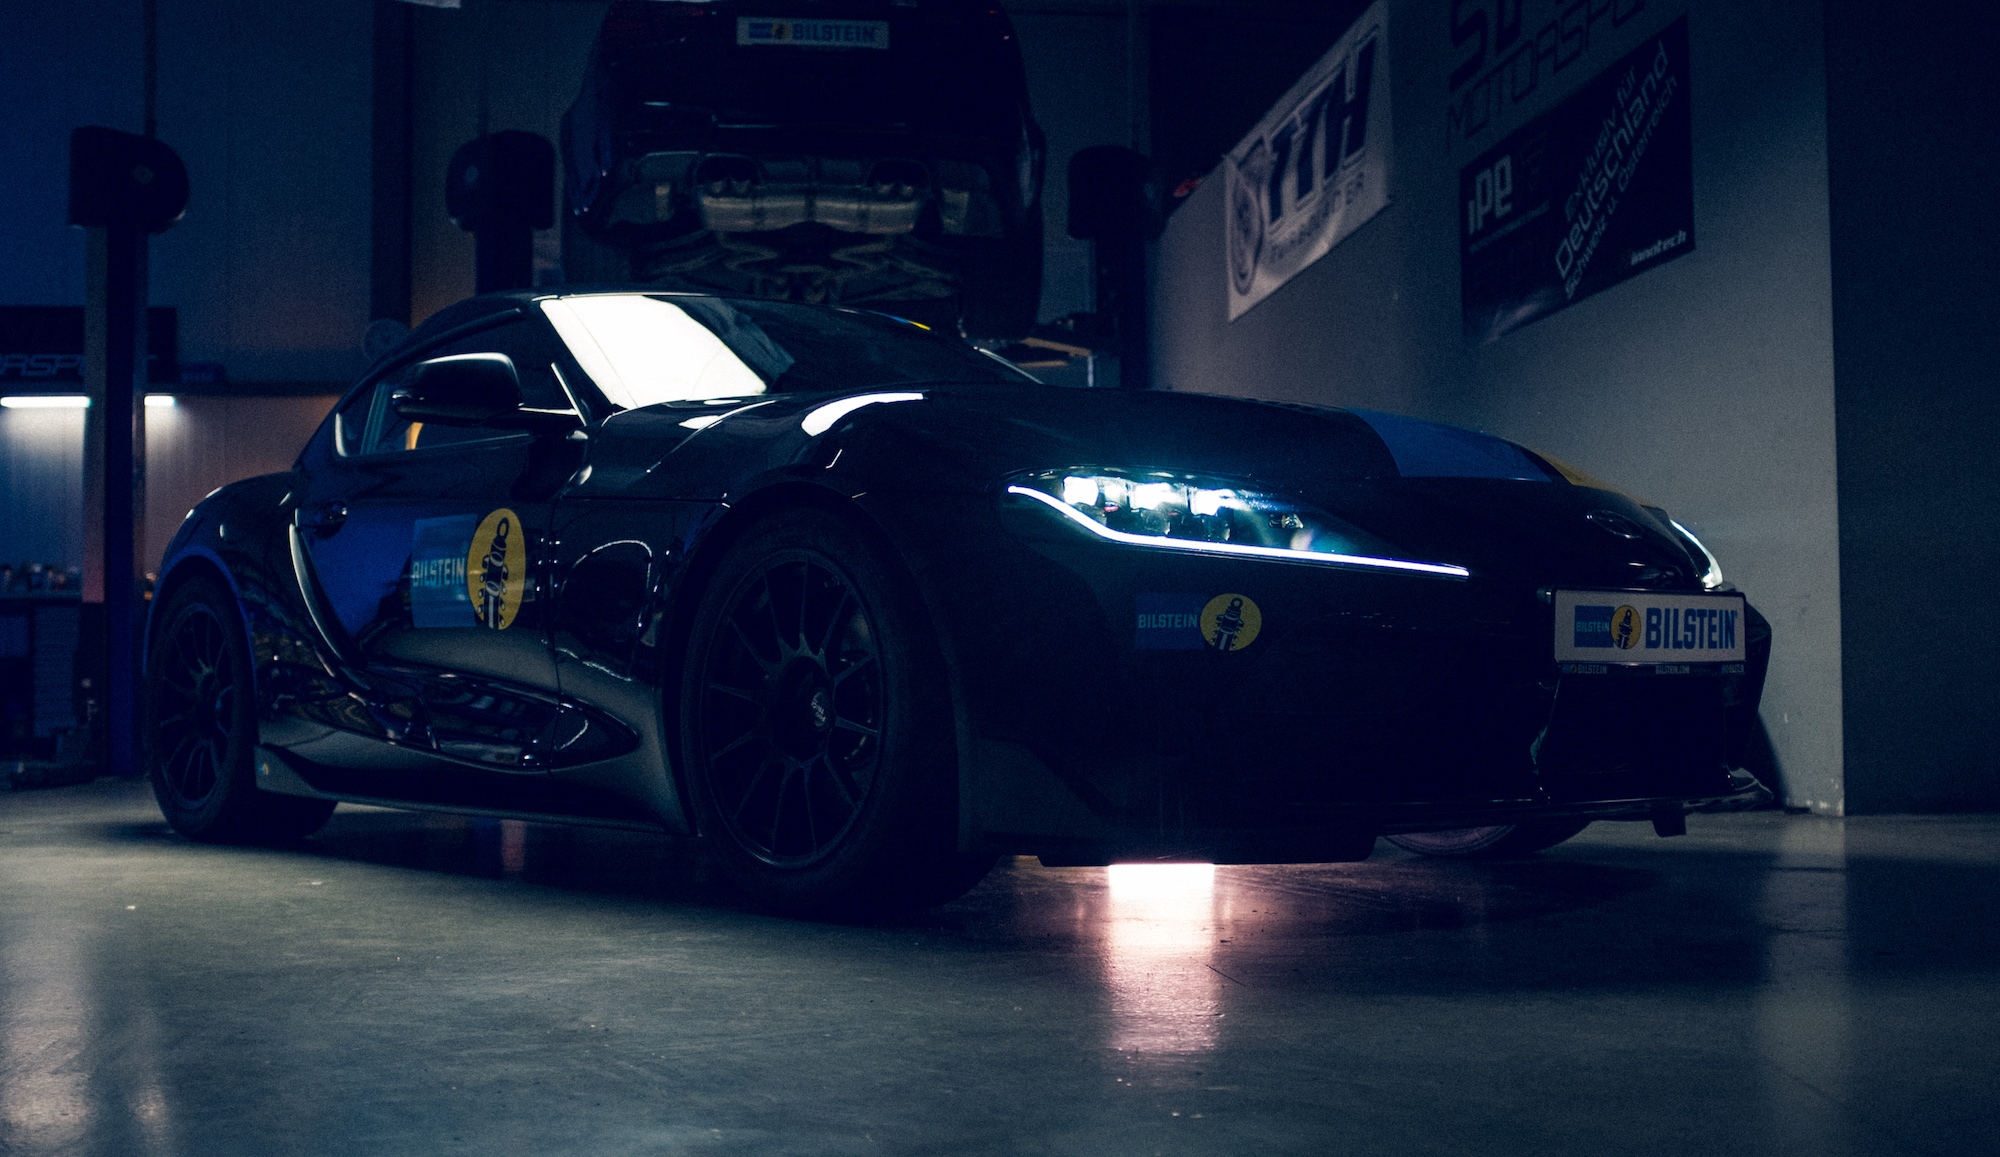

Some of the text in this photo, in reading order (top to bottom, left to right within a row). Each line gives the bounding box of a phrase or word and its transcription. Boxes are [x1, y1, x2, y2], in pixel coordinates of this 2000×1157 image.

[792, 23, 876, 42] BILSTEIN
[1555, 38, 1669, 279] Deutschland
[1565, 213, 1608, 299] Schweiz
[1616, 75, 1678, 193] Österreich
[412, 557, 466, 587] BILSTEIN
[1138, 614, 1198, 628] BILSTEIN
[1575, 621, 1610, 632] BILSTEIN
[1577, 664, 1608, 675] BILSTEIN
